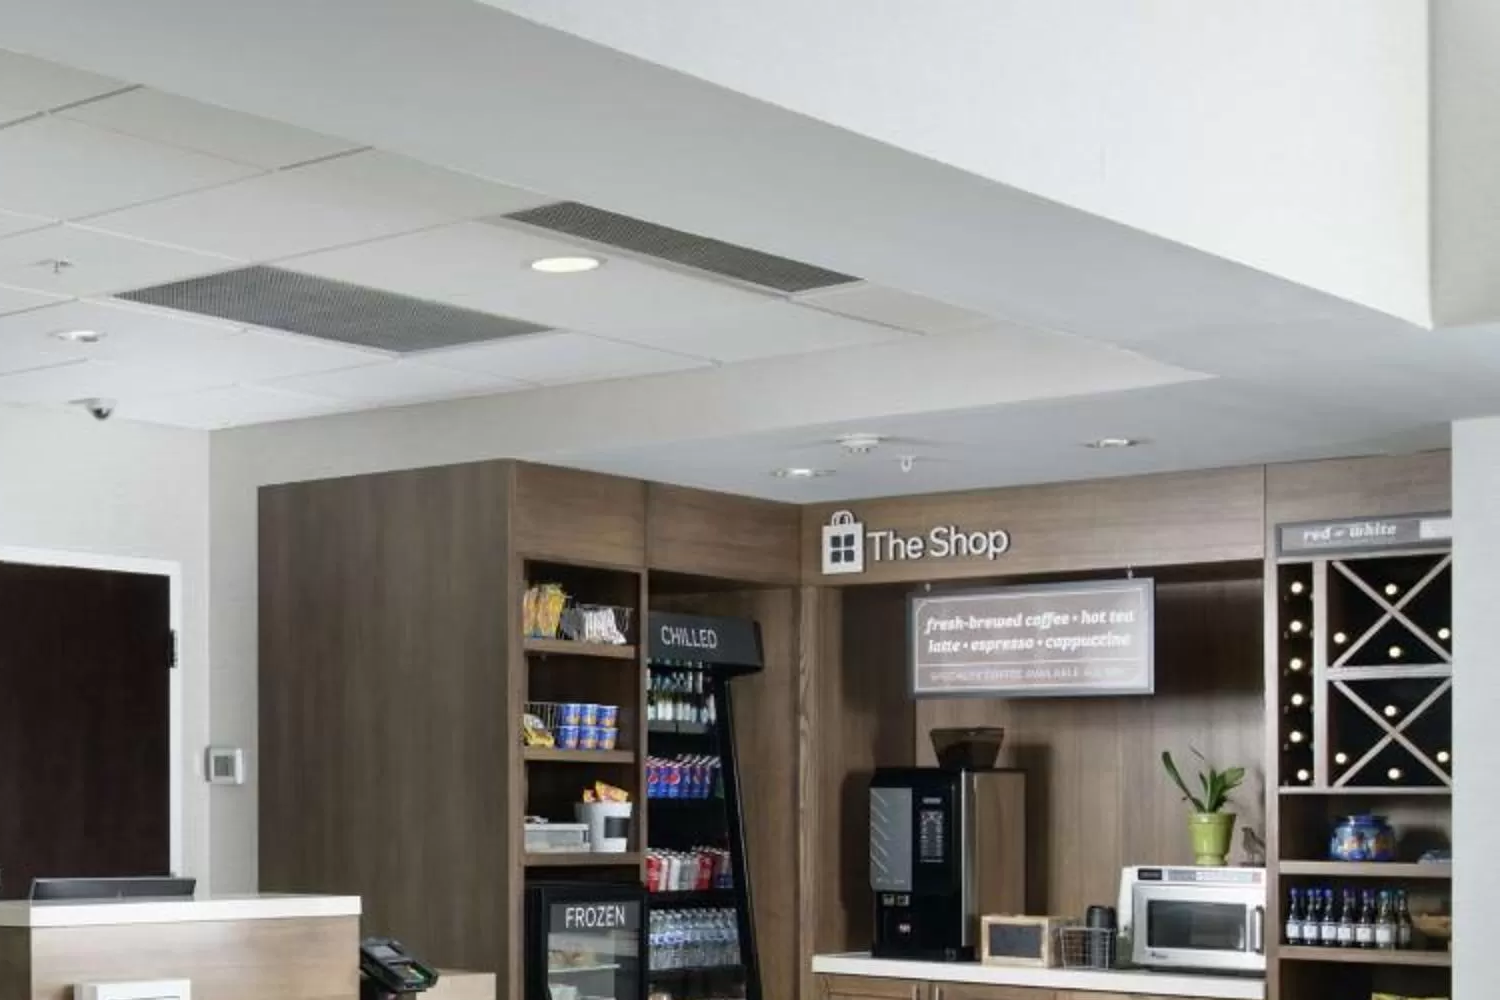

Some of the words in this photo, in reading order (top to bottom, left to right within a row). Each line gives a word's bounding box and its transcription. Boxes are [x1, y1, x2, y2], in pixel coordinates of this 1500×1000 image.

[866, 530, 924, 561] The
[930, 525, 1009, 561] Shop
[924, 612, 1023, 635] fresh-brewed
[1025, 611, 1069, 630] coffee
[1081, 609, 1107, 625] hot
[1109, 611, 1134, 624] tea
[661, 625, 718, 649] CHILLED
[928, 639, 961, 653] latte
[970, 638, 1035, 655] espresso
[565, 904, 626, 929] FROZEN
